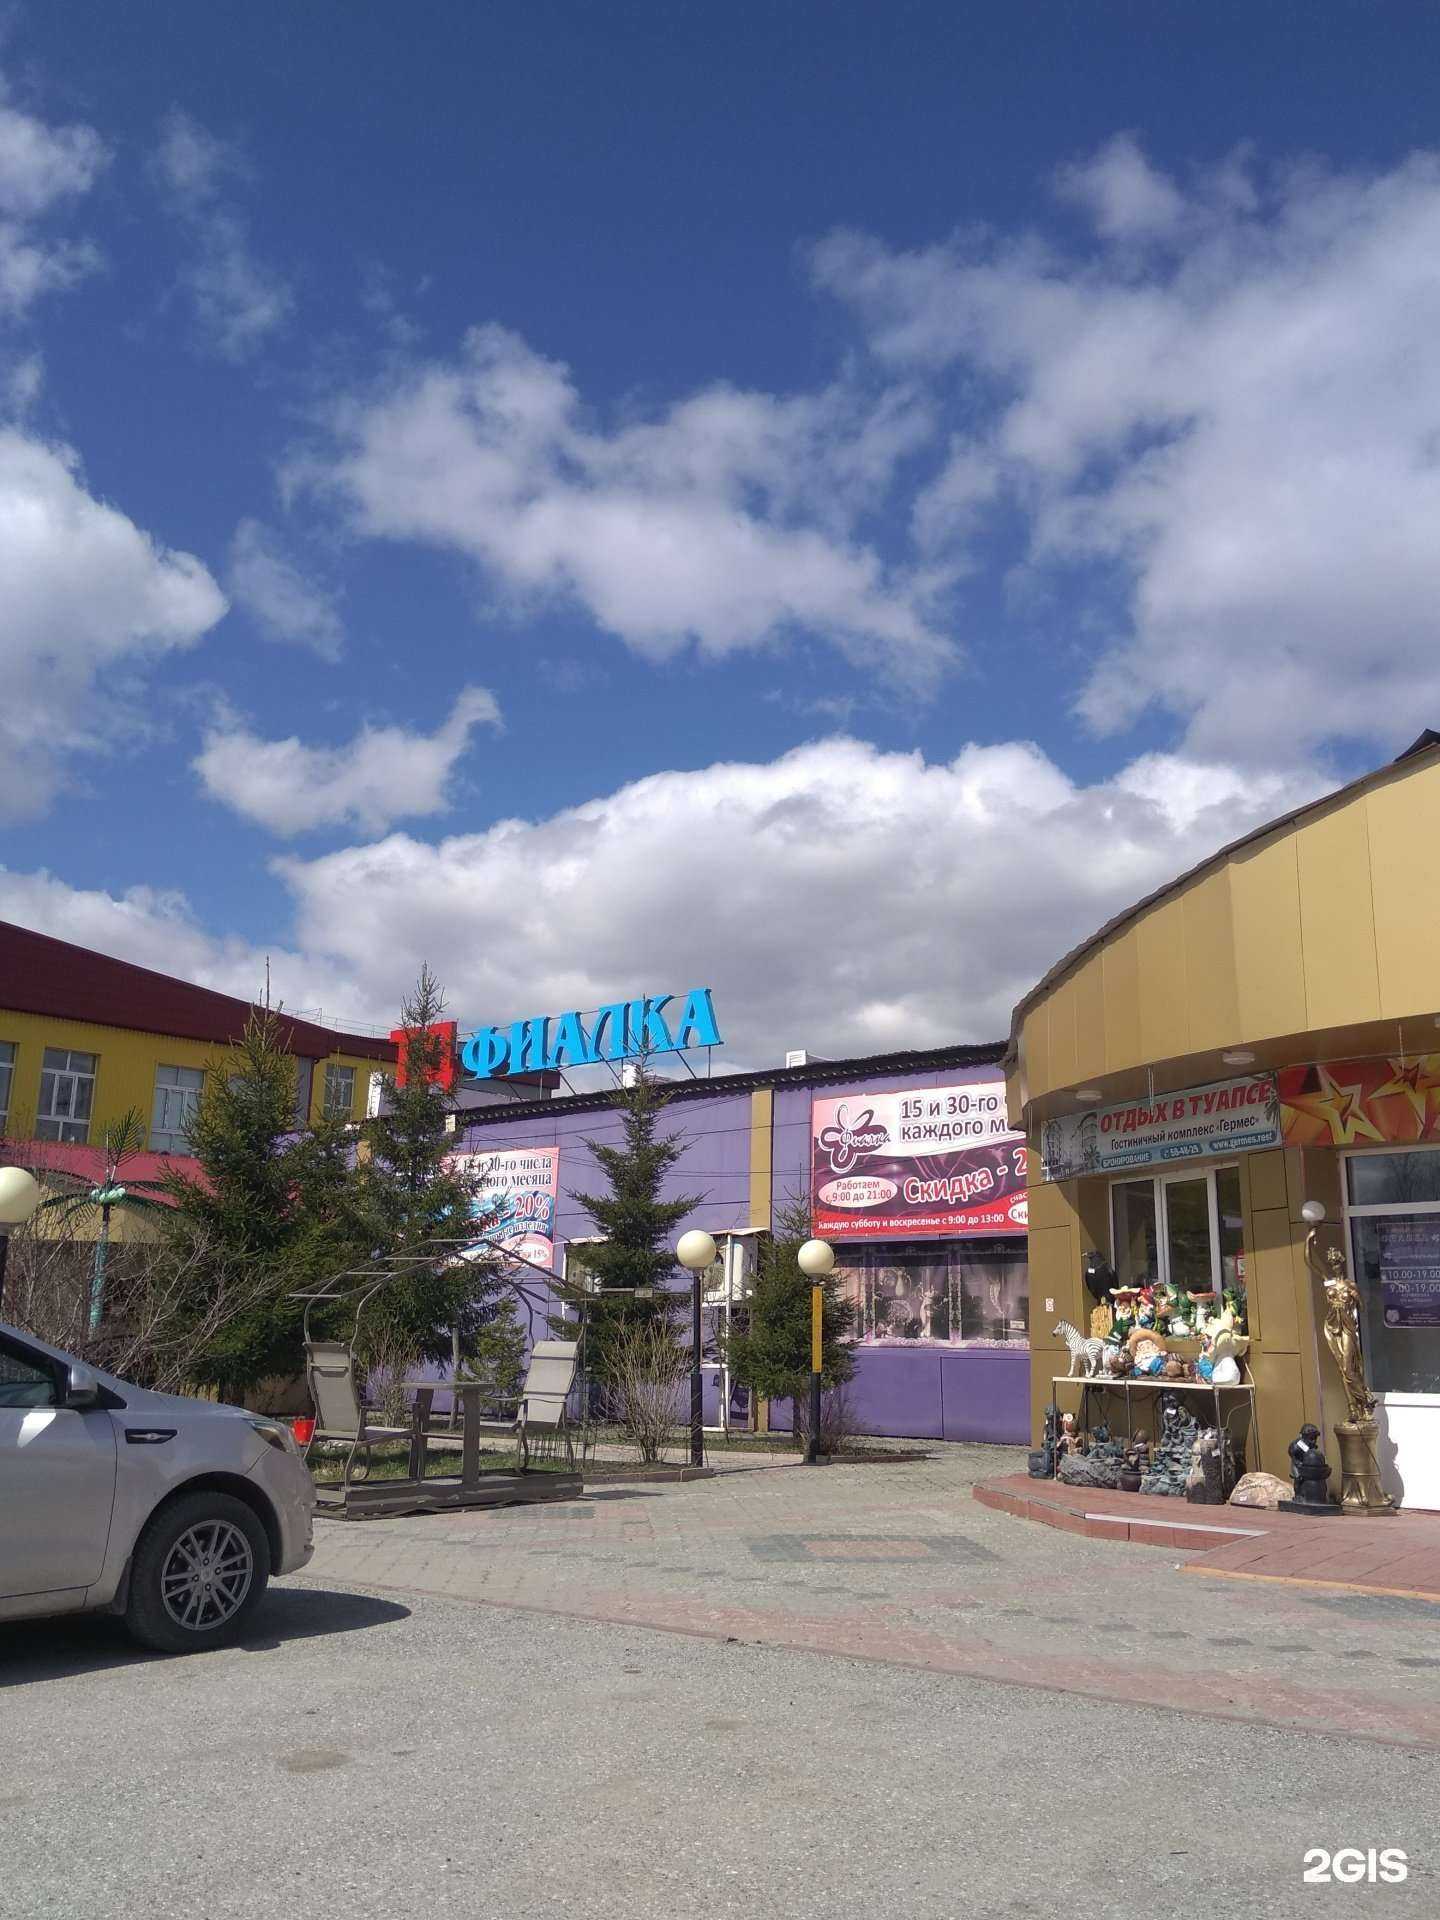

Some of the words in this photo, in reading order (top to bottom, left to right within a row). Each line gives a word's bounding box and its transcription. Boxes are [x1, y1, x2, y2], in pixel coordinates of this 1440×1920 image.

[461, 987, 724, 1080] ФИАЛКА
[901, 1099, 923, 1119] 15
[929, 1101, 941, 1115] и
[947, 1094, 998, 1115] 30-го
[1100, 1102, 1168, 1134] ОТДЫХ
[1172, 1100, 1185, 1121] В
[1189, 1080, 1273, 1117] ТУАПСЕ
[901, 1121, 983, 1142] каждого
[990, 1116, 1009, 1134] м
[1111, 1131, 1166, 1151] Гостиничный
[1168, 1122, 1215, 1141] комплекс
[512, 1173, 552, 1187] месяца
[836, 1180, 880, 1191] Работаем
[903, 1167, 994, 1205] Скидка
[514, 1194, 550, 1219] 20%
[832, 1192, 850, 1202] 9:00
[852, 1192, 864, 1203] до
[867, 1189, 892, 1200] 21:00
[850, 1219, 881, 1229] субботу
[889, 1216, 940, 1228] воскресенье
[948, 1215, 966, 1224] 9:00
[968, 1216, 979, 1226] до
[981, 1214, 1004, 1223] 13:00
